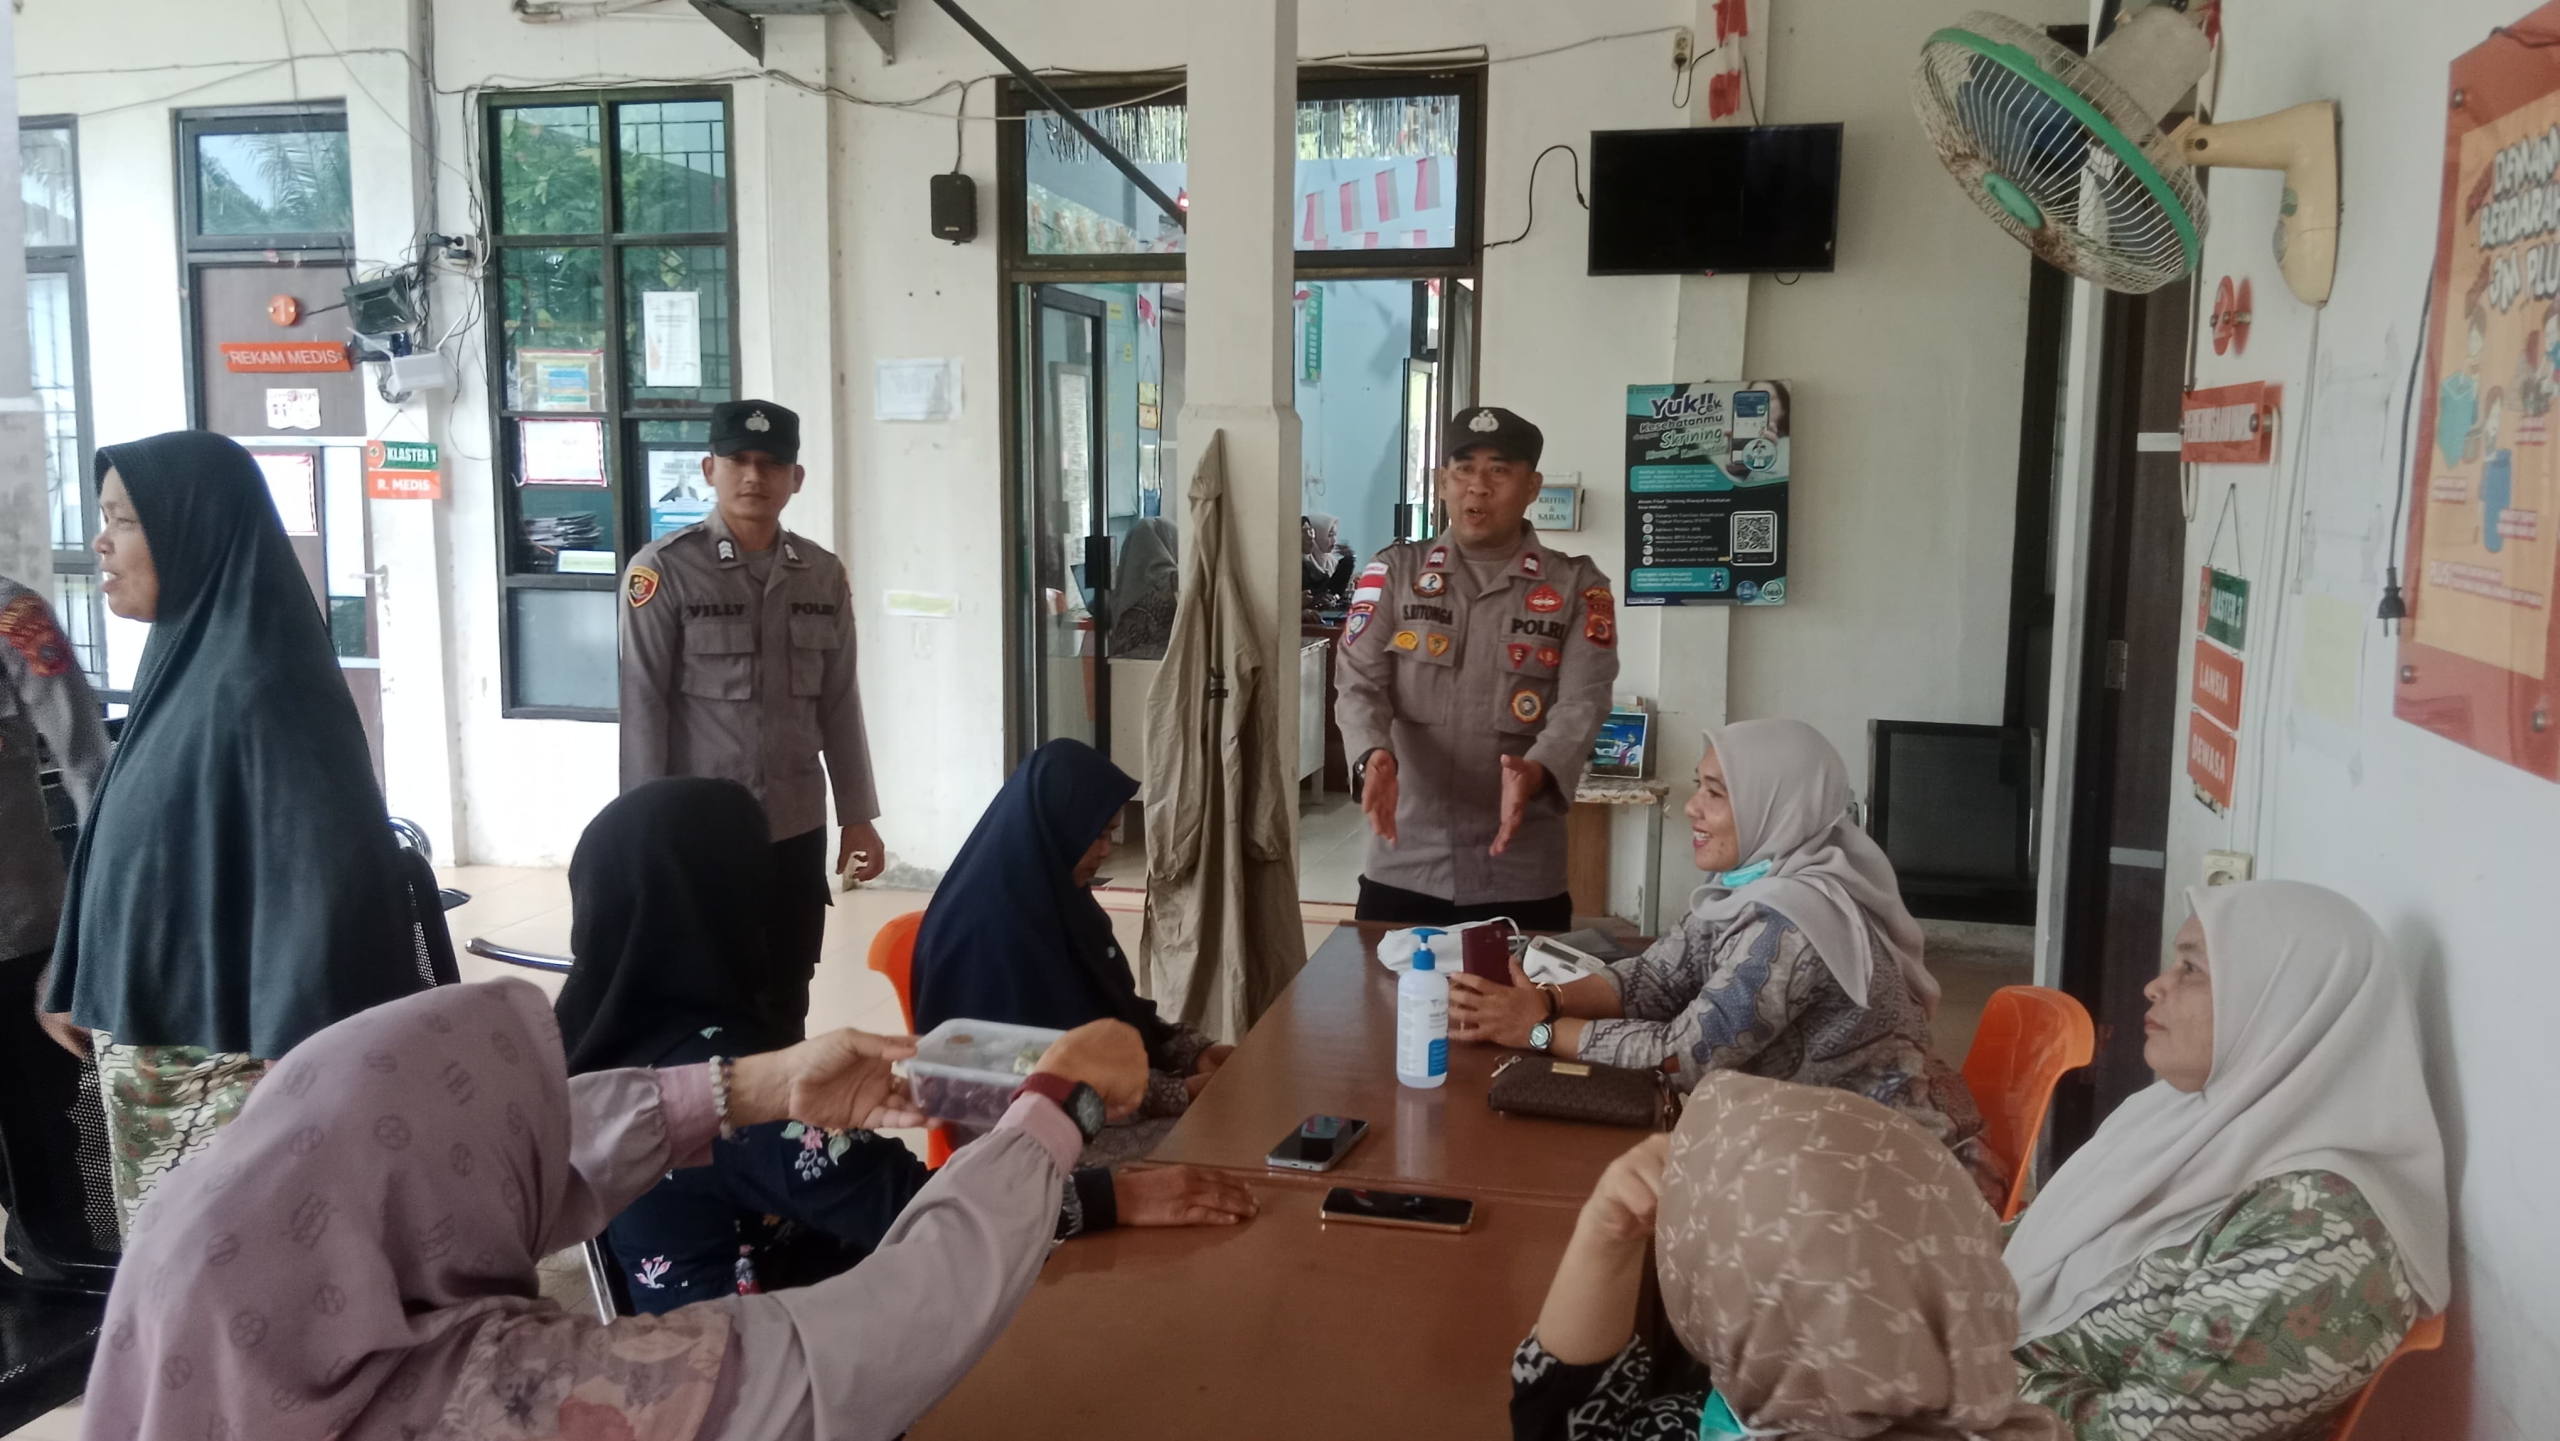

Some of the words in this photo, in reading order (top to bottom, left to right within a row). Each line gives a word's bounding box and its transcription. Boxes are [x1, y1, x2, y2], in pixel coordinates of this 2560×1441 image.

[230, 350, 285, 366] REKAM
[288, 349, 338, 365] MEDIS
[1640, 414, 1723, 433] Kesehatanmu
[1660, 428, 1722, 449] Skrining
[387, 447, 430, 462] KLASTER
[431, 449, 437, 463] 1
[377, 479, 390, 491] R.
[392, 479, 431, 491] MEDIS
[1538, 496, 1567, 504] KRITIK
[1537, 513, 1567, 521] SARAN
[1510, 618, 1566, 639] POLRI
[2199, 661, 2229, 705] LANSIA
[2192, 732, 2226, 785] DEWASA
